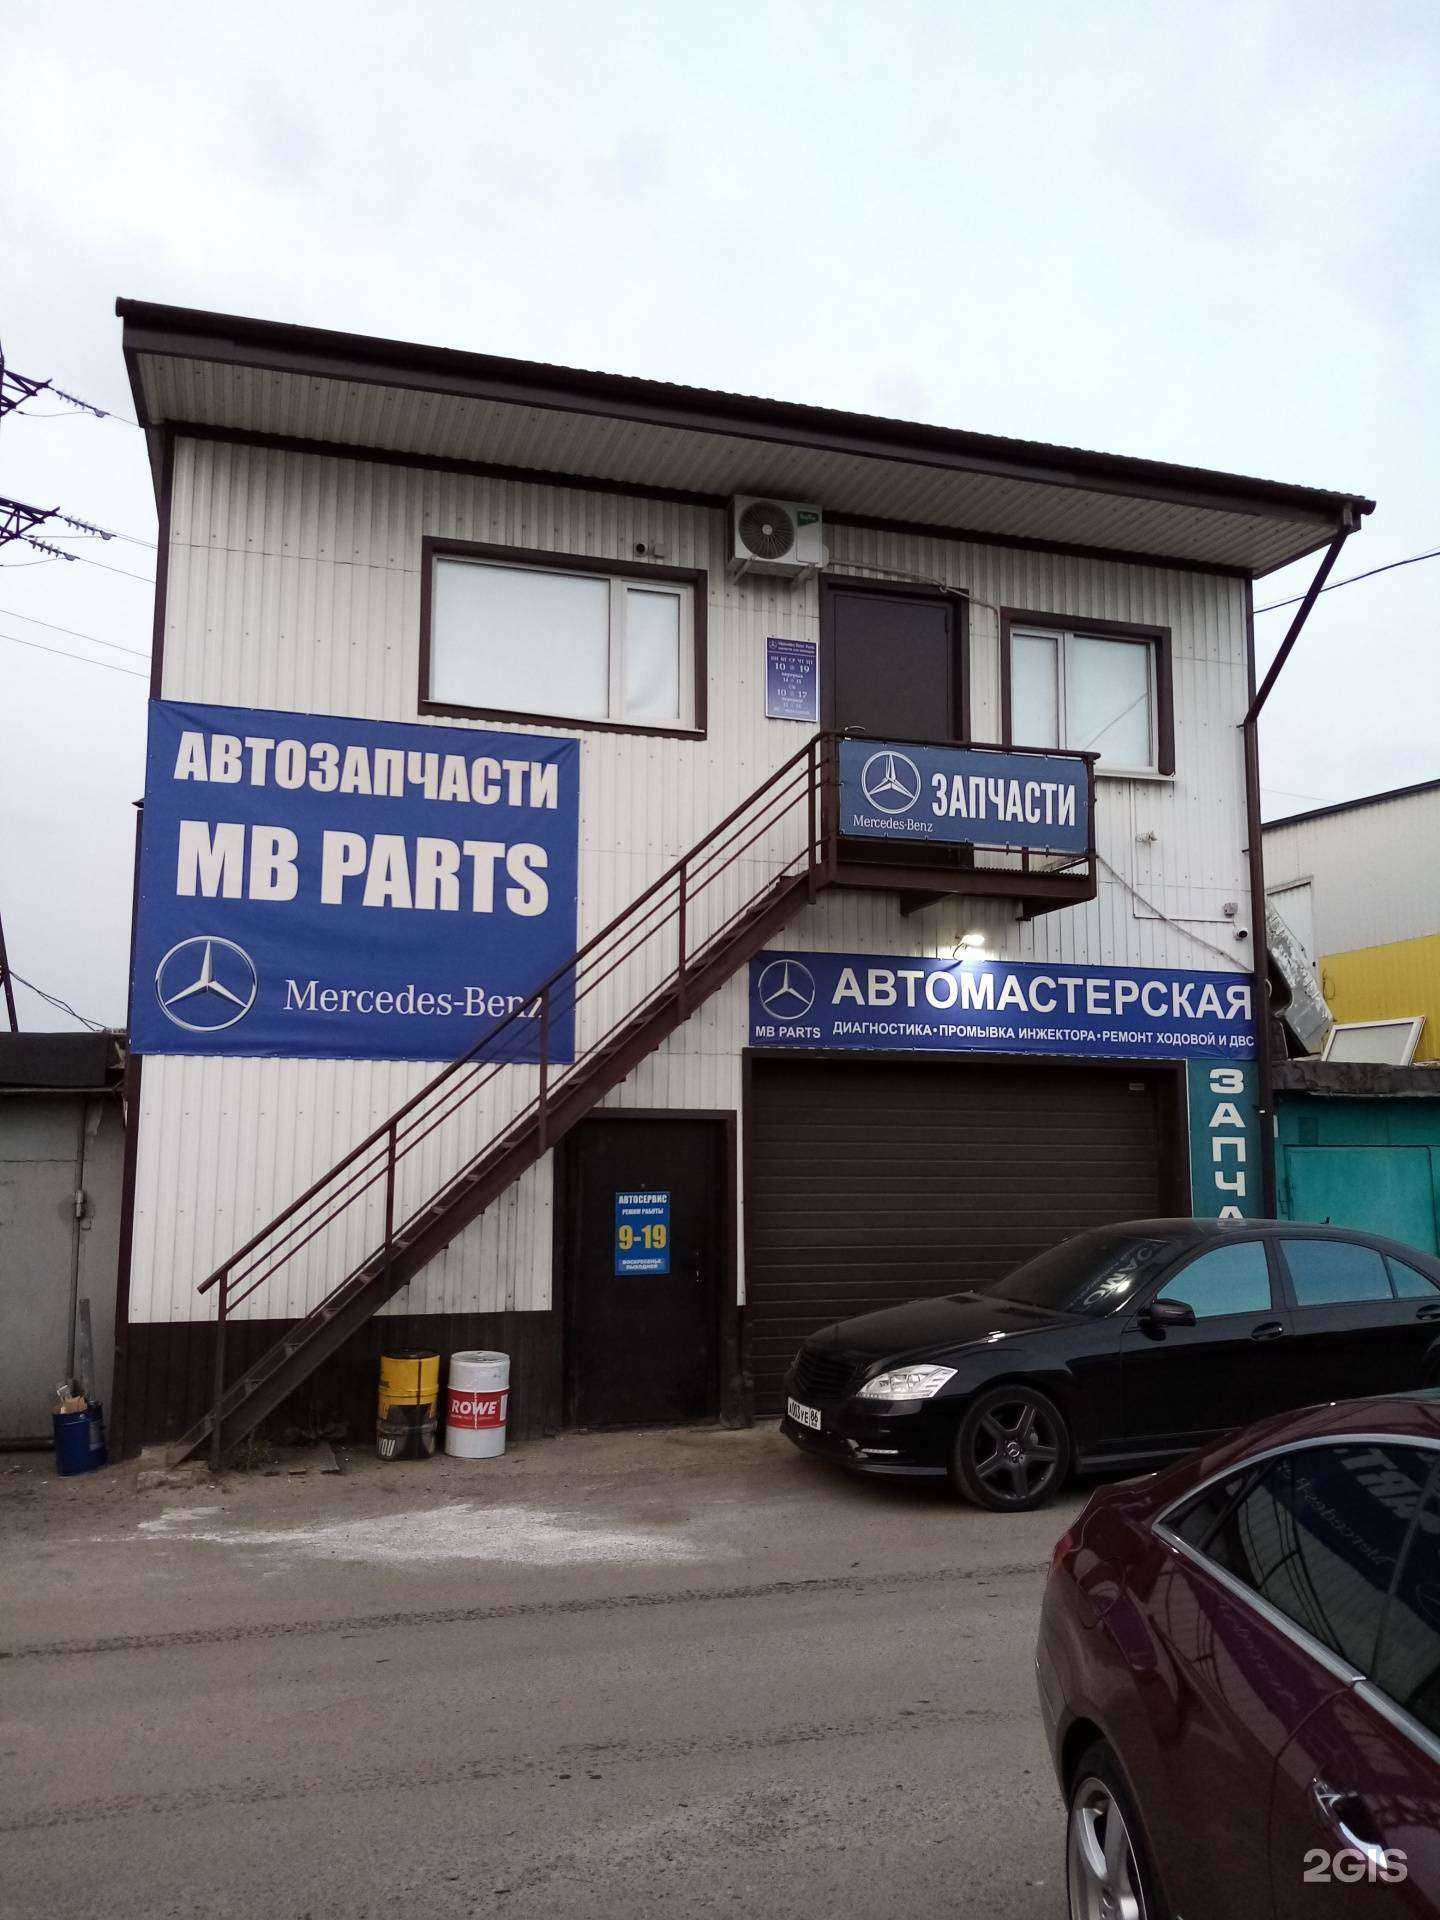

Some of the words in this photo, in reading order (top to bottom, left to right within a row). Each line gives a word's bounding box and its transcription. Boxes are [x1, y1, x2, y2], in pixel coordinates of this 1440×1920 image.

[775, 662, 786, 671] 10
[800, 665, 810, 673] 19
[777, 688, 787, 697] 10
[173, 730, 558, 810] АВТОЗАПЧАСТИ
[931, 772, 1076, 827] ЗАПЧАСТИ
[852, 814, 934, 833] Mercedes-Benz
[176, 819, 299, 902] MB
[320, 829, 549, 917] PARTS
[831, 967, 1252, 1021] АВТОМАСТЕРСКАЯ
[755, 1025, 774, 1038] MB
[779, 1026, 821, 1039] PARTS
[1156, 1031, 1218, 1047] ХОДОВОЙ
[1219, 1035, 1227, 1046] И
[1229, 1035, 1254, 1048] ДВС
[618, 1194, 667, 1204] АВТОСЕРВИС
[619, 1224, 667, 1250] 9-19
[451, 1399, 497, 1415] ROWE
